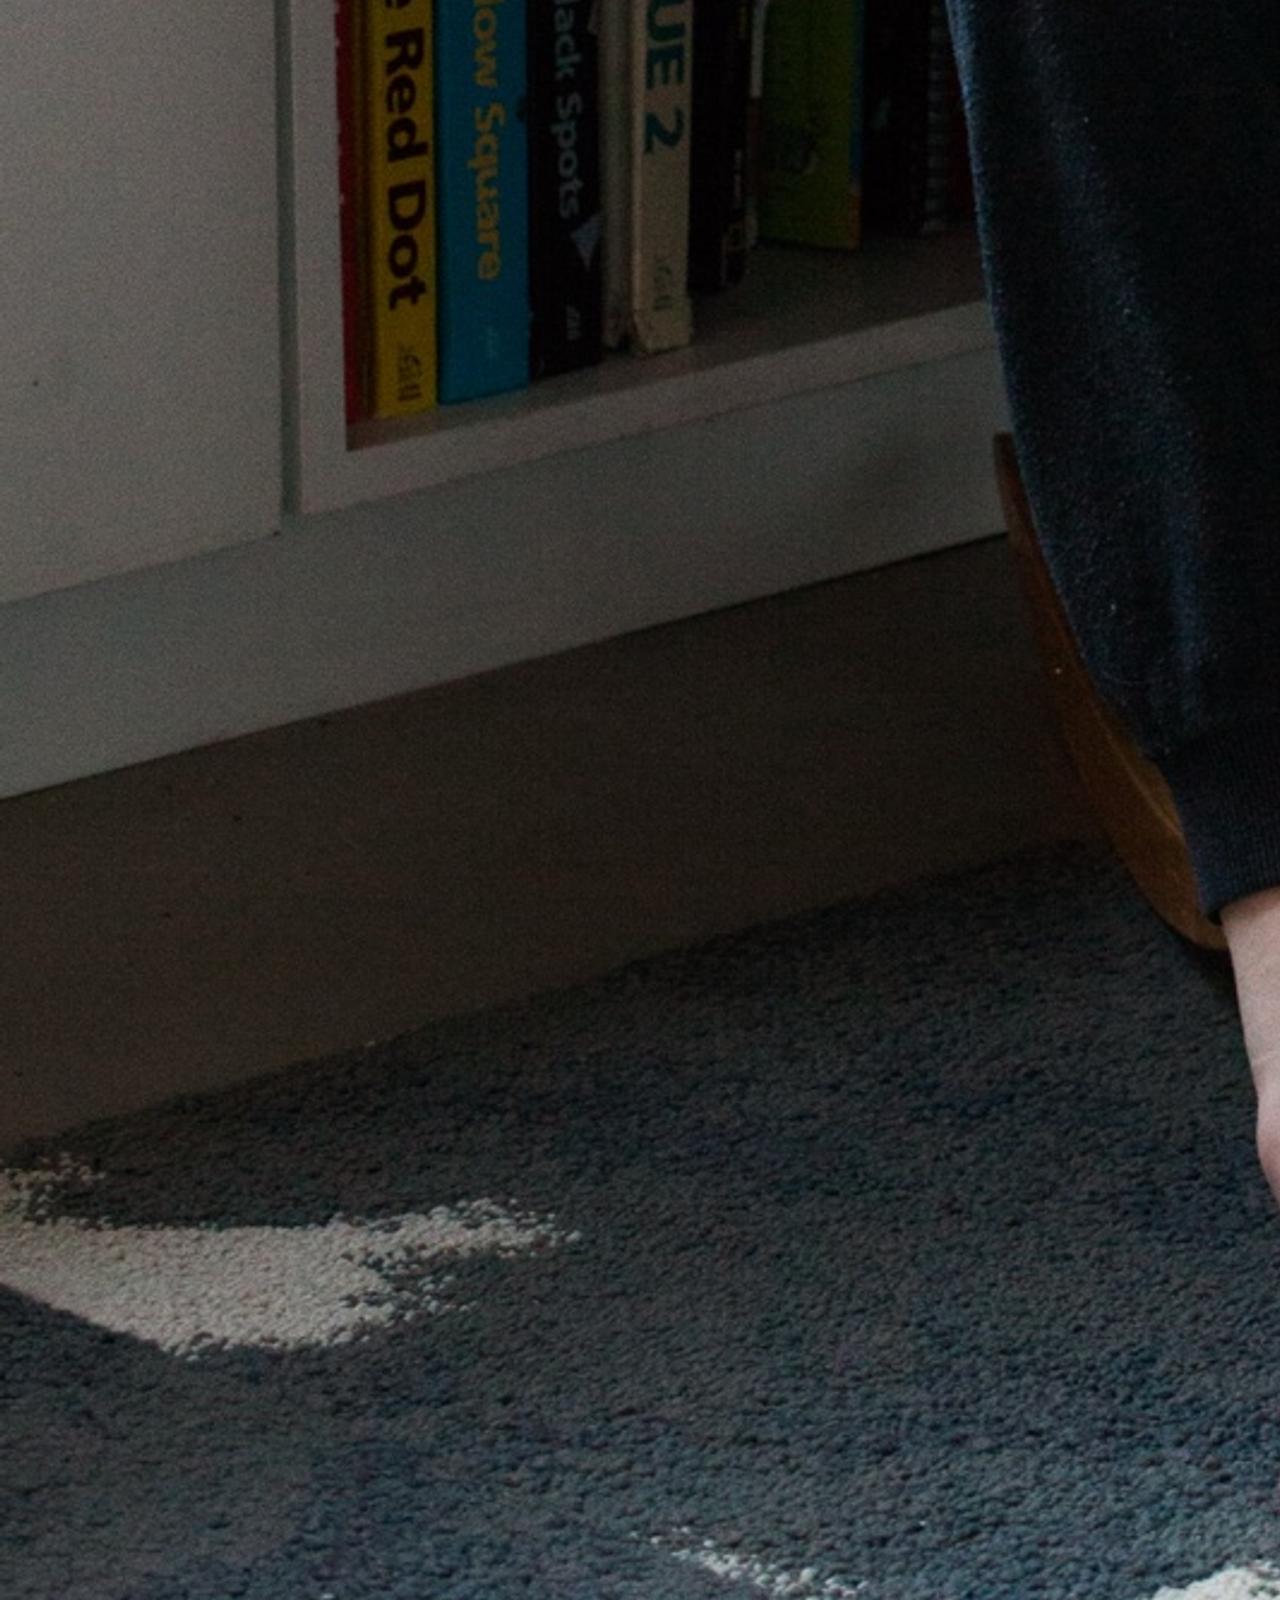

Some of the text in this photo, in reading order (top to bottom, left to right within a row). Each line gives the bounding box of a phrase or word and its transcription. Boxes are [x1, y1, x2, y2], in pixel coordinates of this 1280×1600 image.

[384, 26, 428, 162] Red
[550, 99, 583, 219] Spots
[644, 109, 685, 155] 2
[387, 180, 429, 311] Dot
[466, 102, 507, 282] Square
